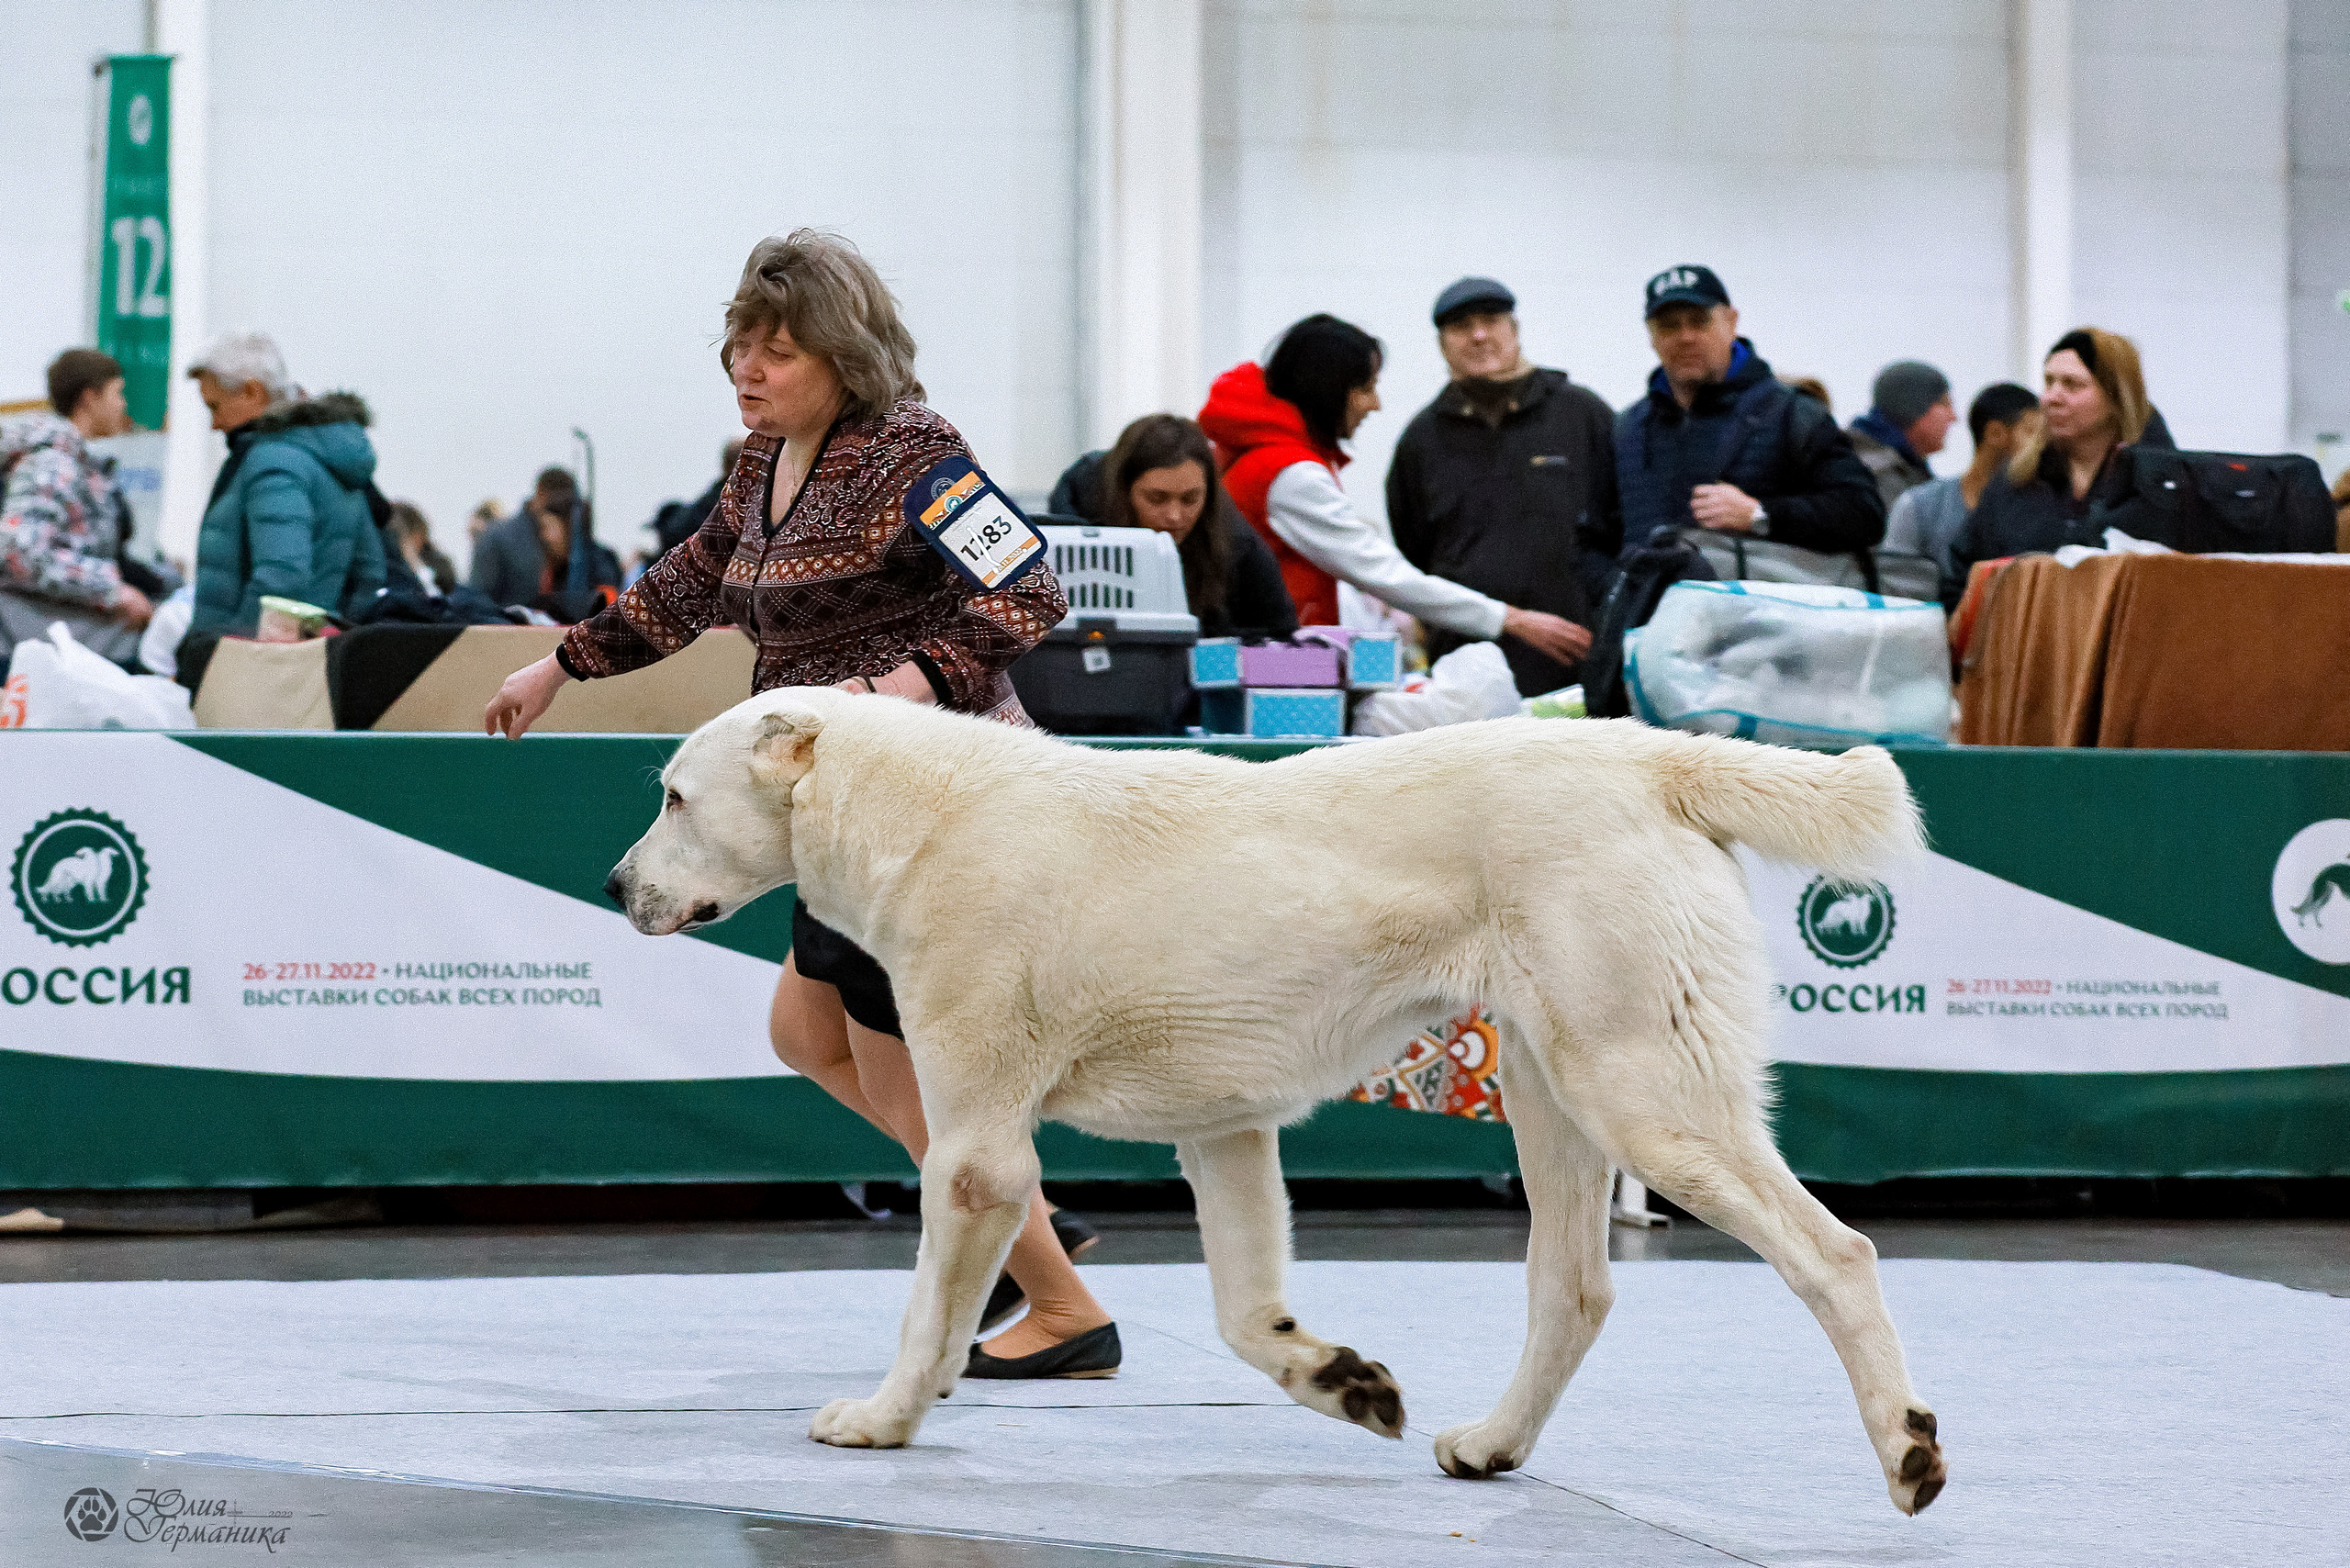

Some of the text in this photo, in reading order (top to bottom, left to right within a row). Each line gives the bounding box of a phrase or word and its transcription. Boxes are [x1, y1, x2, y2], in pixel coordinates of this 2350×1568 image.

[112, 216, 169, 318] 12
[243, 962, 592, 981] 26-27.11.2022 НАЦИОНАЛЬНЫЕ
[243, 988, 602, 1008] ВЫСТАВКИ СОБАК ВСЕХ ПОРОД
